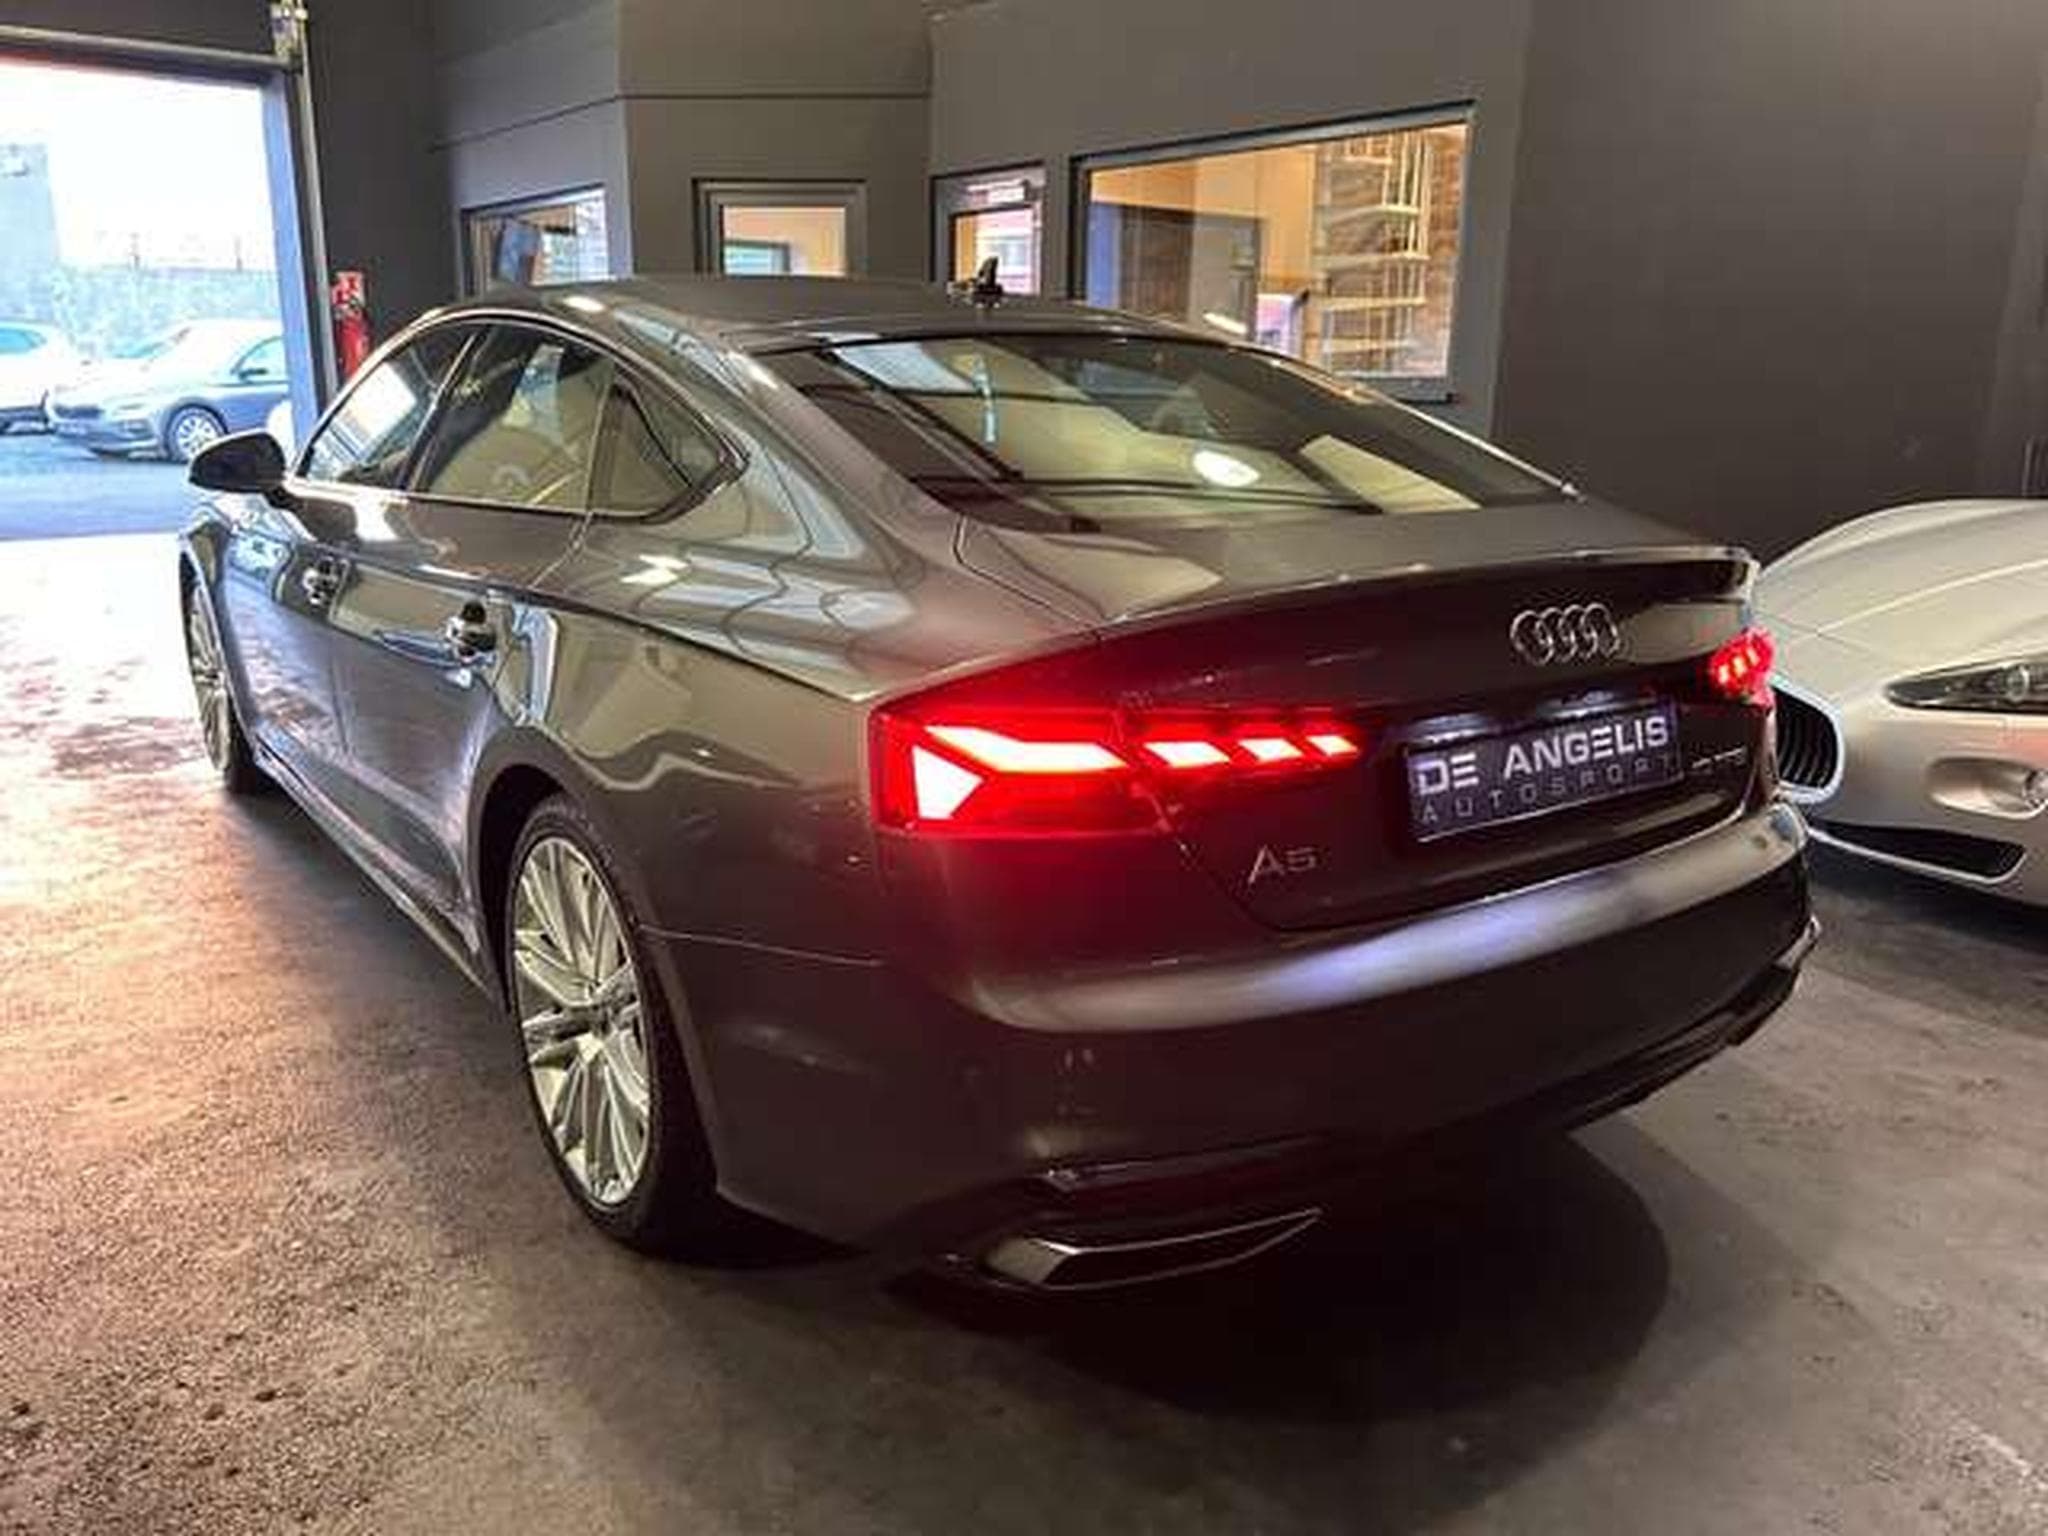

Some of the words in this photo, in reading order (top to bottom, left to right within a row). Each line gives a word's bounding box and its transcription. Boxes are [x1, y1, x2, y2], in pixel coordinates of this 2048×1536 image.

[1417, 753, 1479, 796] DE
[1504, 716, 1670, 780] ANGELIS
[1421, 755, 1672, 823] AUTOSPORT
[1248, 844, 1316, 884] A5
